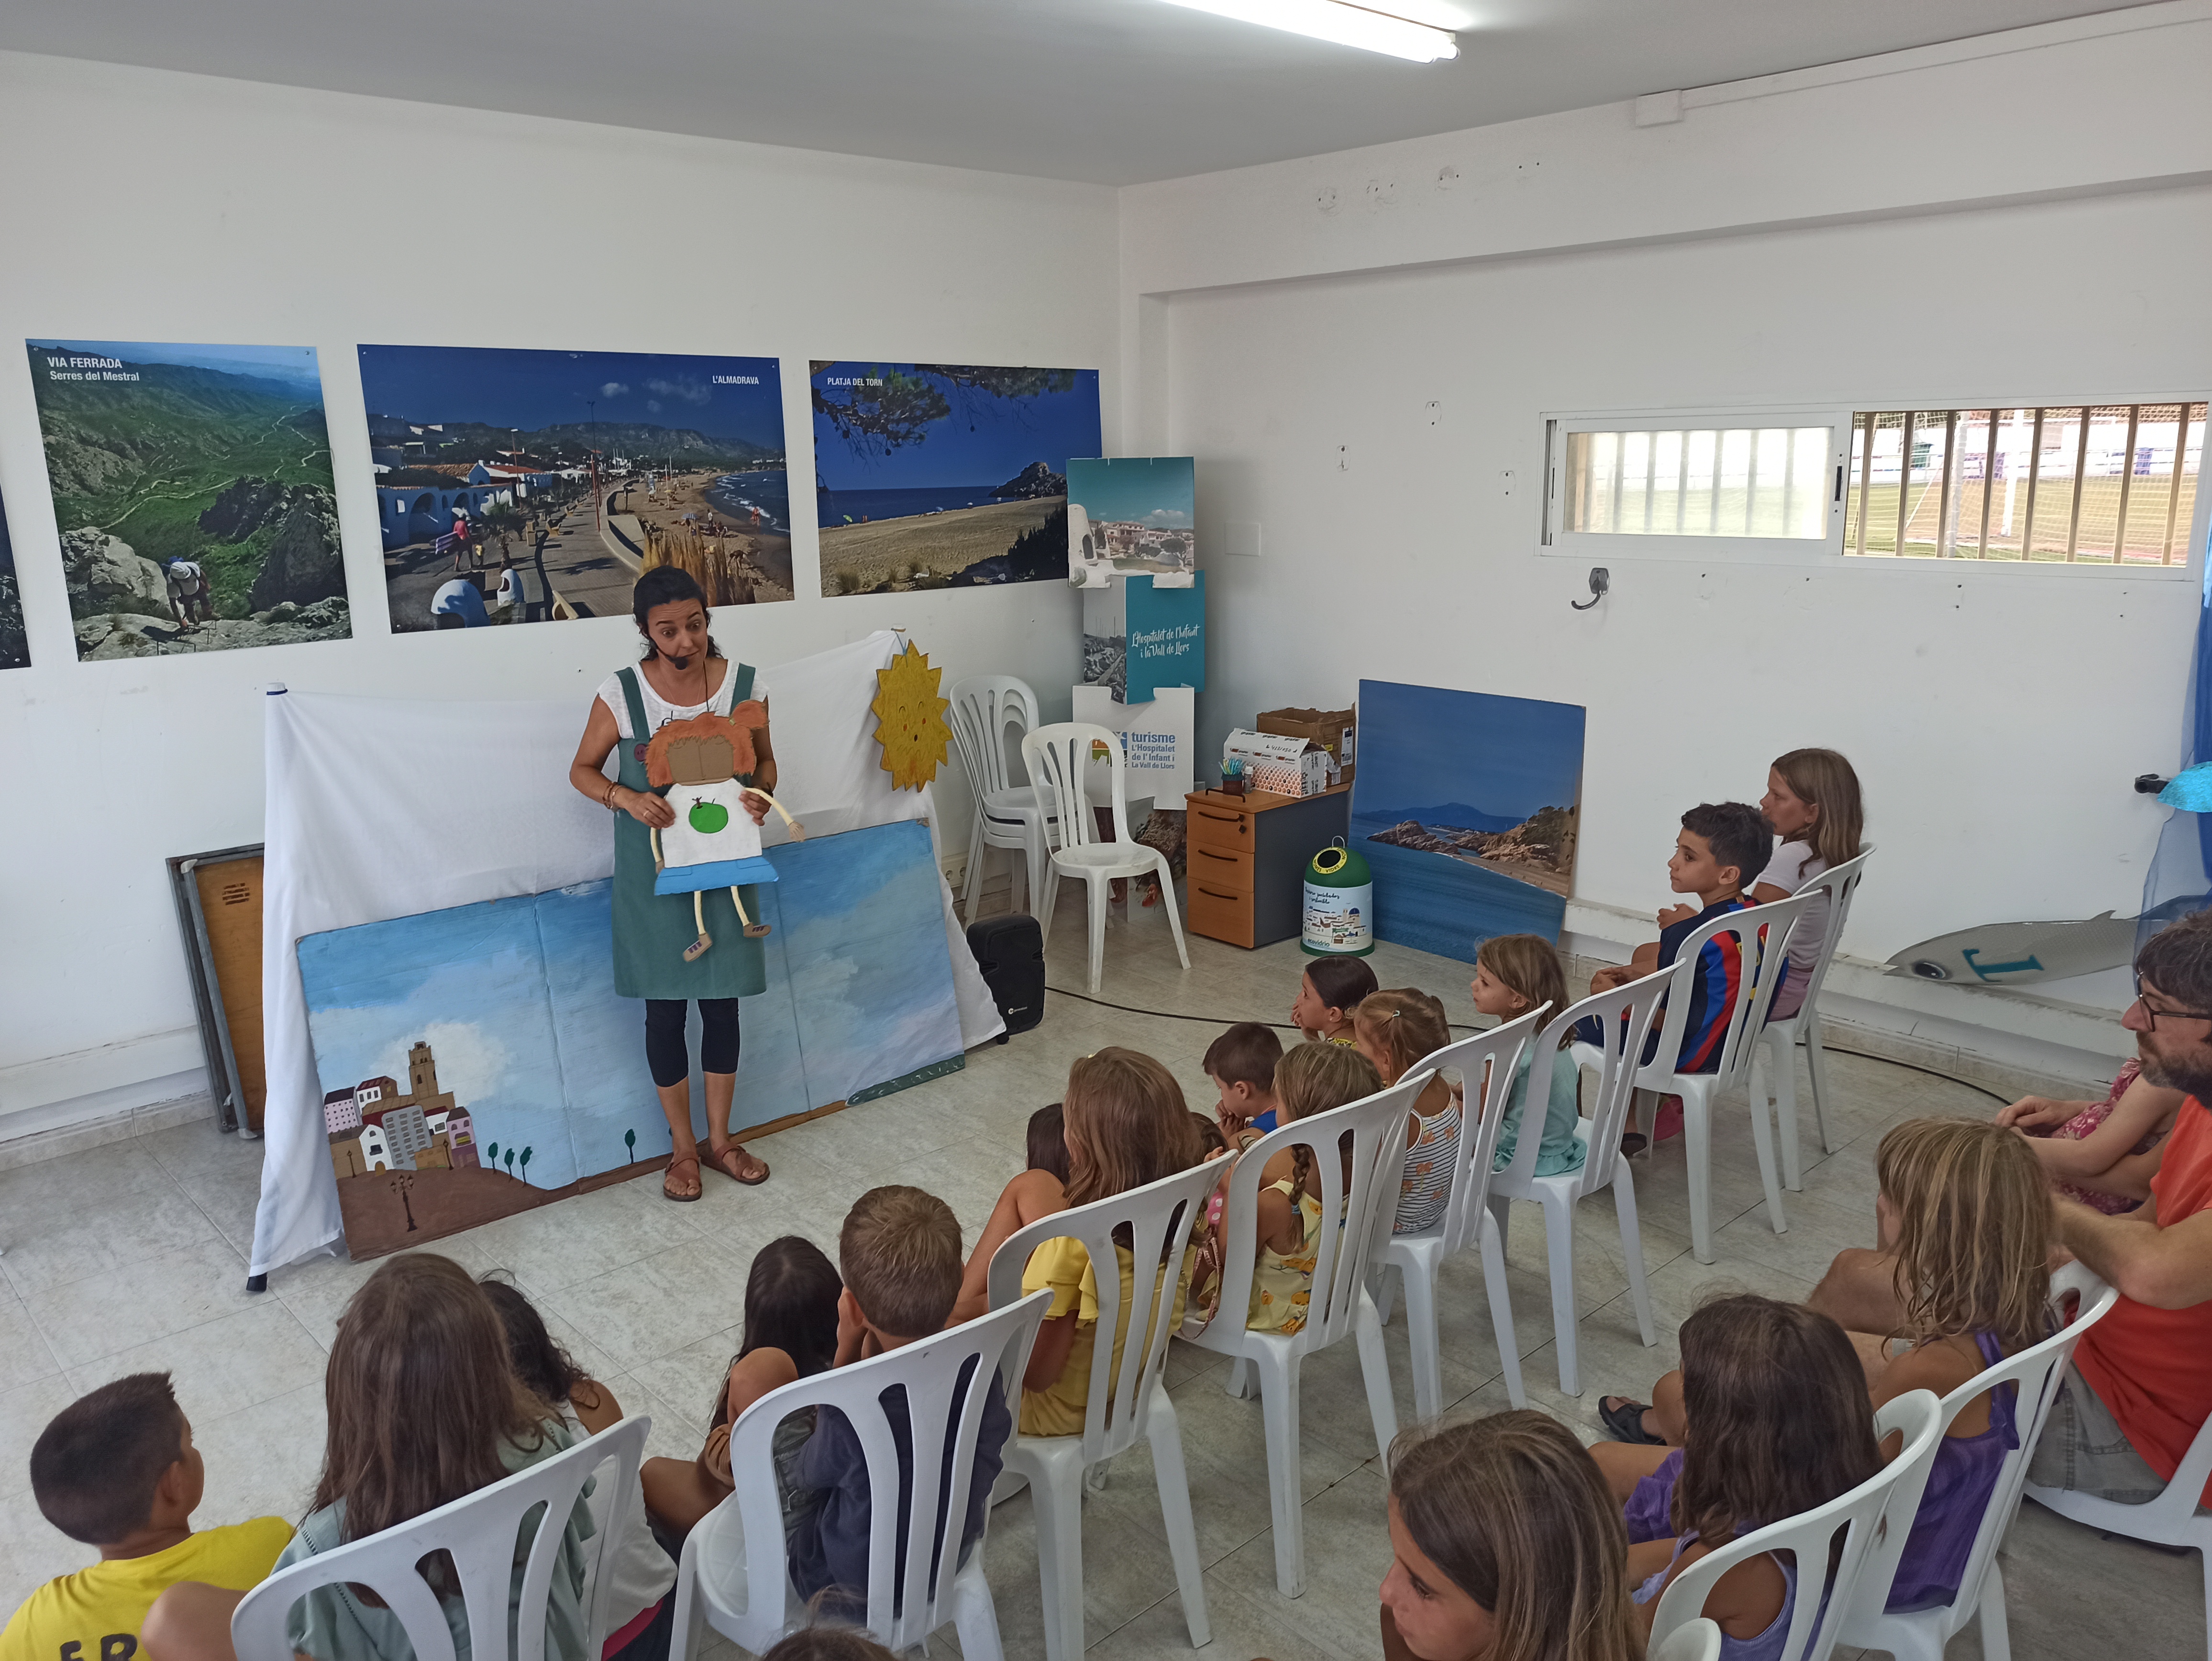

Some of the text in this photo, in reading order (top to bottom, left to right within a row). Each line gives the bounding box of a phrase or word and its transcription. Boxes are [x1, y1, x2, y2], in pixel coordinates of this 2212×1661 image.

[47, 356, 122, 368] VIA FERRADA
[50, 370, 139, 381] Serres del Mestral
[712, 375, 759, 385] L'ALMADRAVA
[827, 377, 851, 386] PLATJA
[865, 378, 883, 387] TORN
[1166, 628, 1174, 640] de
[1140, 649, 1143, 658] i
[1144, 646, 1151, 658] la
[1149, 643, 1165, 656] Vall
[1166, 643, 1174, 655] de
[1131, 732, 1175, 743] turisme
[1131, 744, 1175, 753] L'Hospitalet
[1307, 938, 1330, 947] ecovidrio
